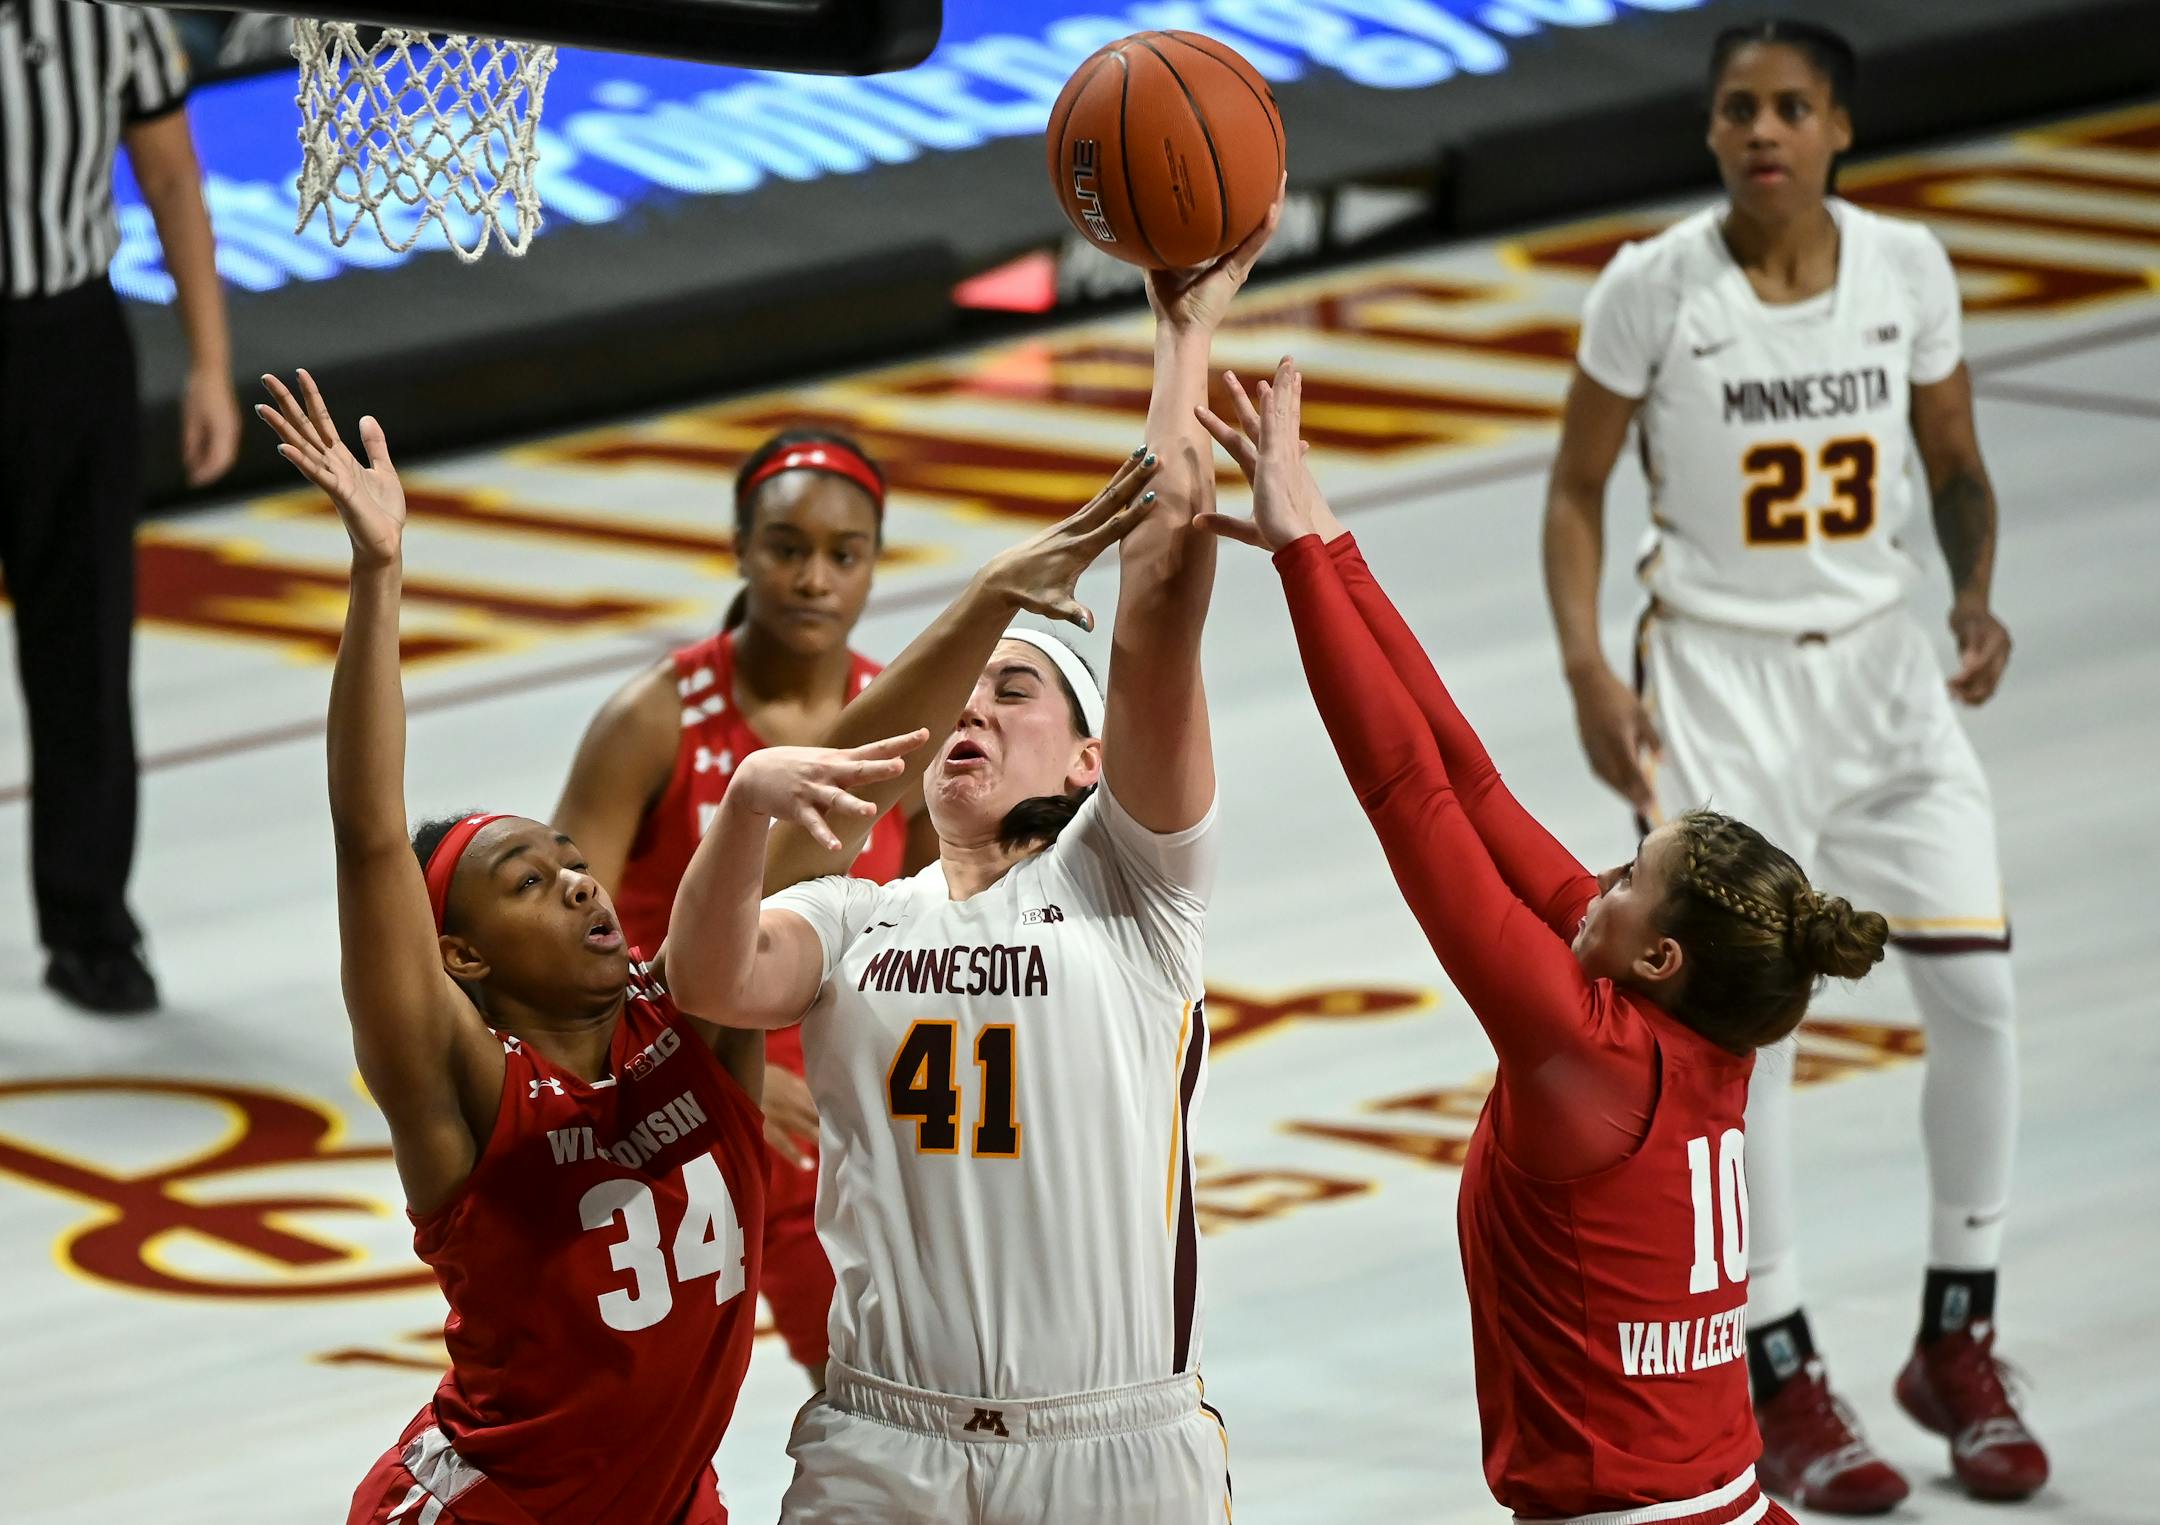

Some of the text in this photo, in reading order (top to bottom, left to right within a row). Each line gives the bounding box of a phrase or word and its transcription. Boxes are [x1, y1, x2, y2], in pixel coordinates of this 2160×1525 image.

[1722, 367, 1891, 424] MINNESOTA
[1741, 434, 1876, 547] 23
[857, 943, 1048, 997] MINNESOTA
[887, 1019, 1022, 1160] 41
[547, 1090, 708, 1170] WIONSIN
[578, 1152, 746, 1332] 34
[1687, 1128, 1749, 1294] 10
[1618, 1303, 1748, 1376] VAN LEEU
[963, 1408, 1010, 1438] M
